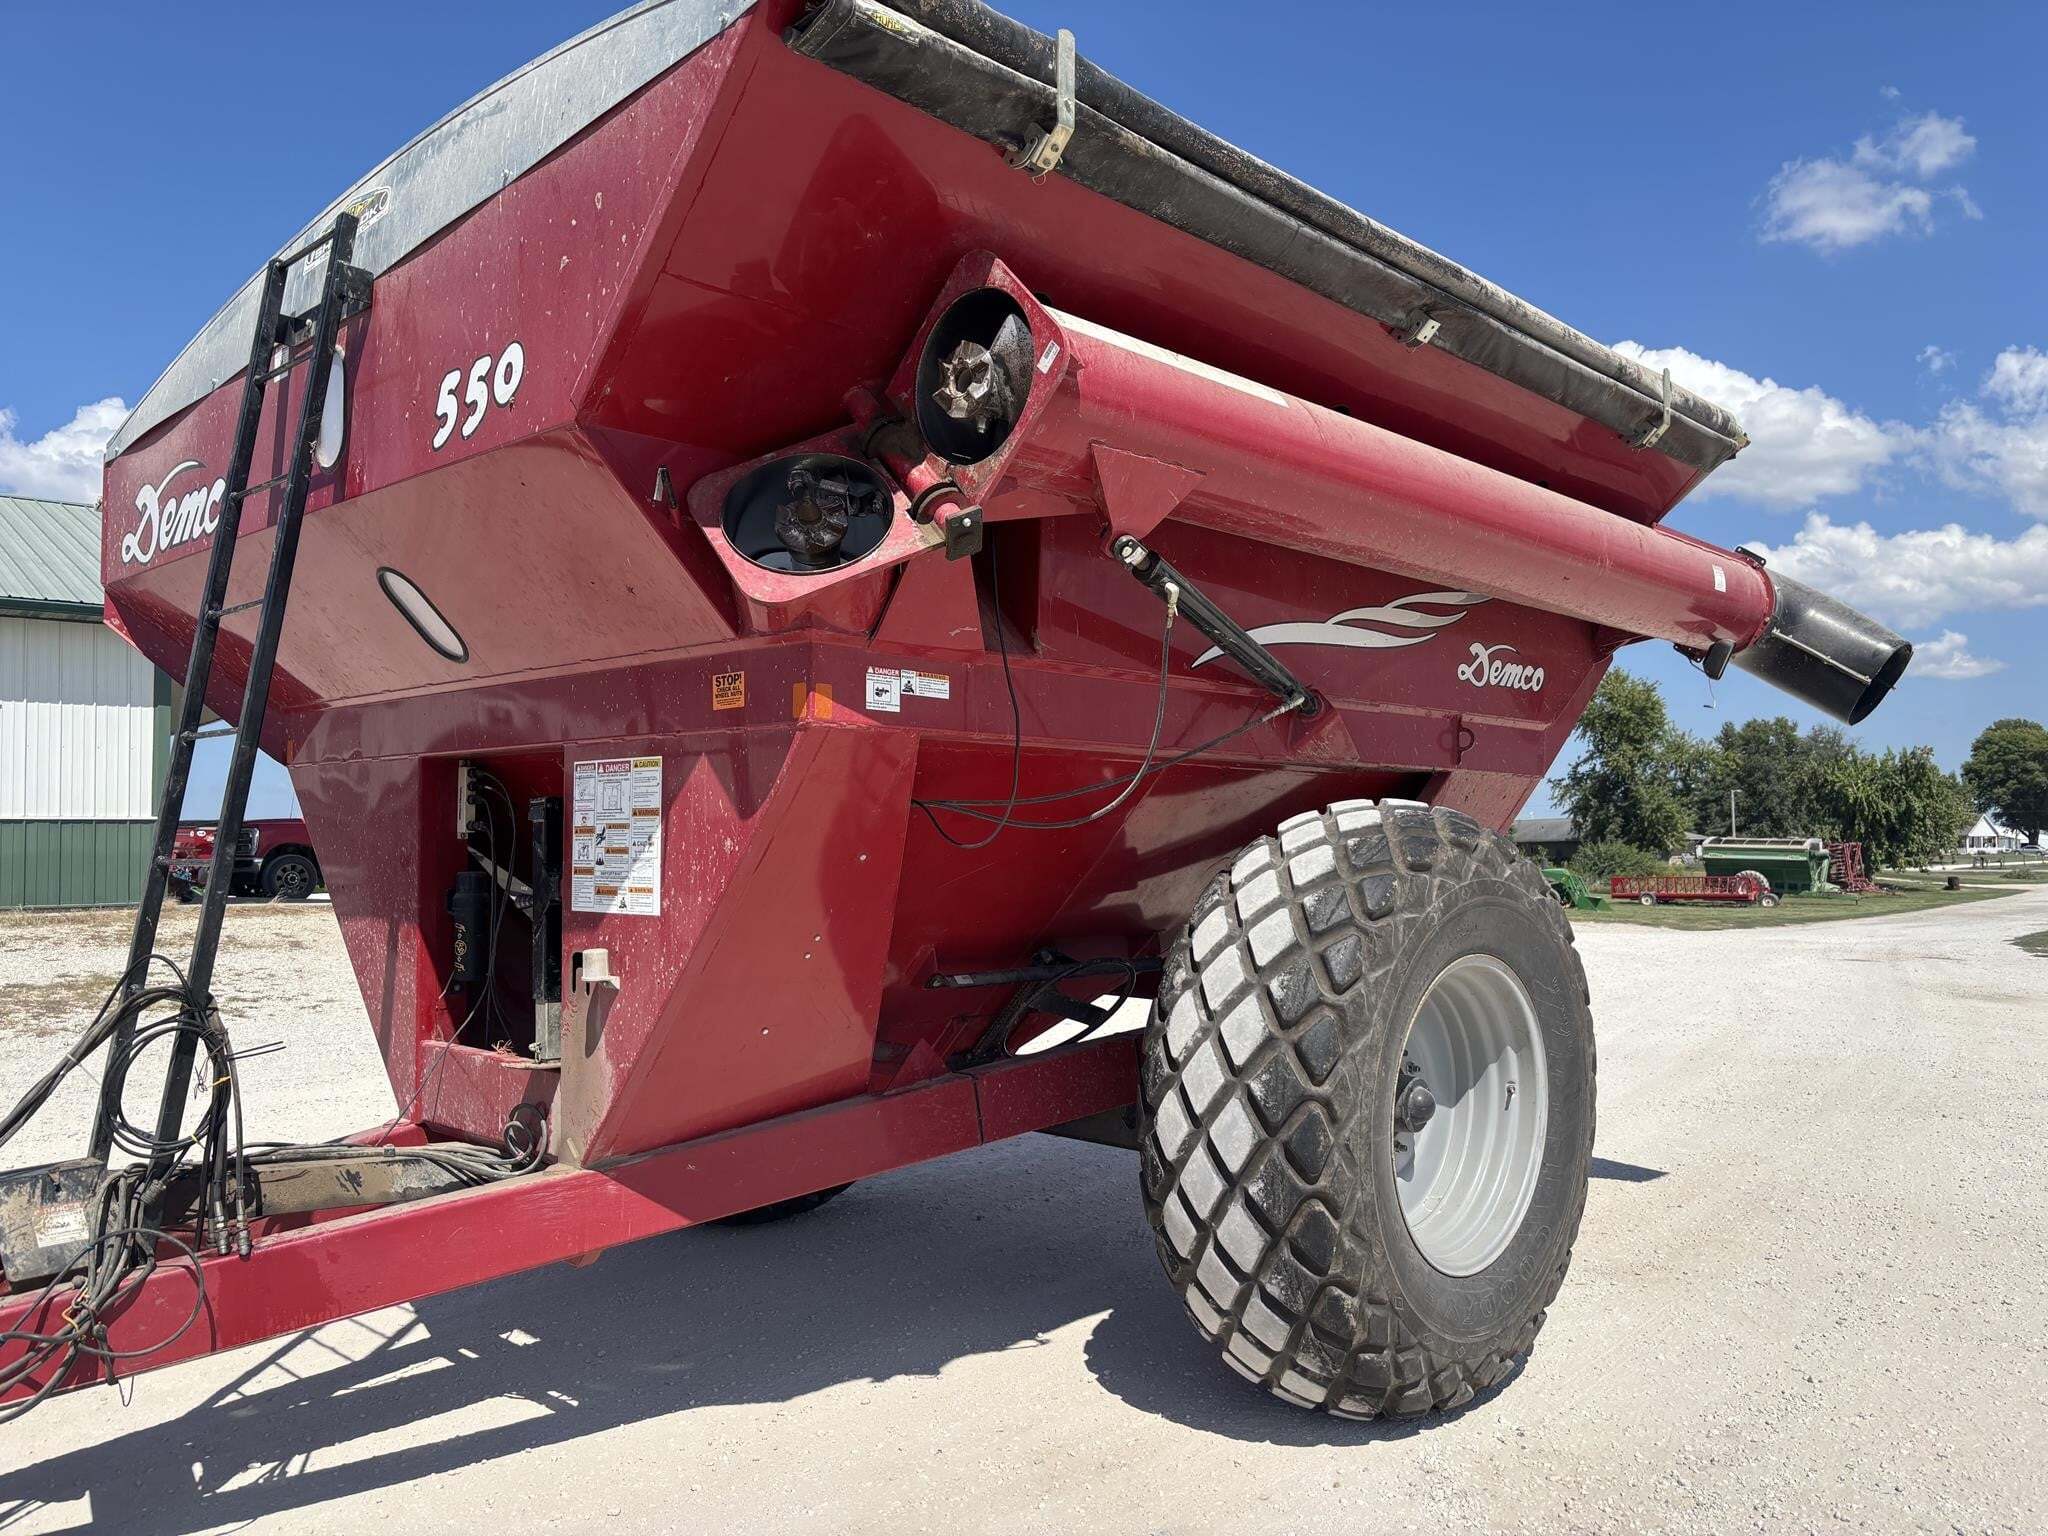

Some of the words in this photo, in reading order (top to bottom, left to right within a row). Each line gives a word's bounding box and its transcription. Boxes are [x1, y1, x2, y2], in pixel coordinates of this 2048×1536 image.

[432, 340, 525, 452] 550
[121, 460, 226, 564] Demc
[874, 667, 900, 676] DANGER
[1456, 641, 1545, 692] Demco
[715, 672, 742, 688] STOP!
[605, 763, 631, 773] DANGER
[639, 760, 659, 768] CAUTION
